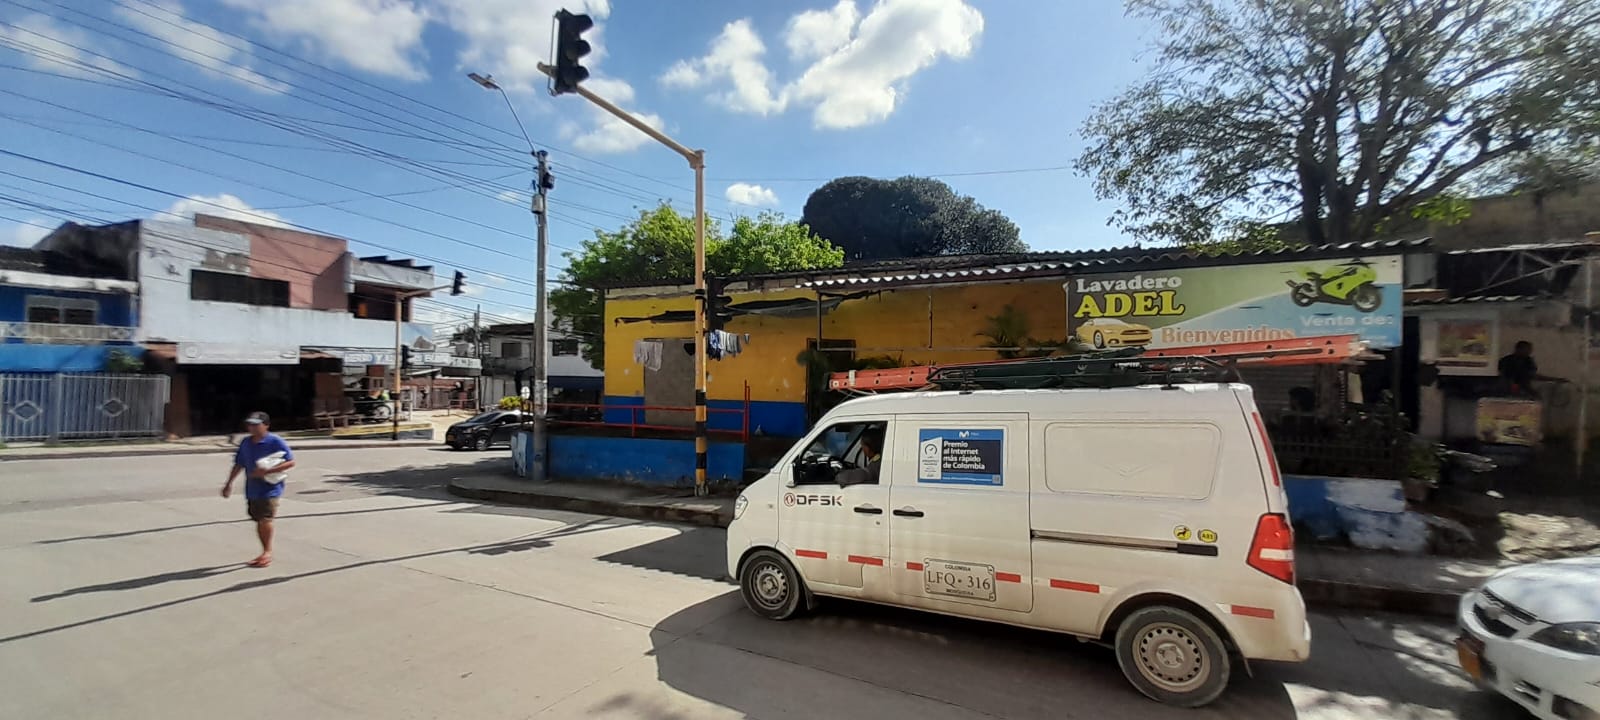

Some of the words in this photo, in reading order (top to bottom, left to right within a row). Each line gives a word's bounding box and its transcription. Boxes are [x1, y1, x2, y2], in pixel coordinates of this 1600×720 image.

[1076, 275, 1182, 292] Lavadero
[1073, 290, 1185, 318] ADEL
[1301, 315, 1355, 327] Venta
[1361, 314, 1393, 325] de:
[1161, 324, 1296, 342] Bienvenidos
[958, 455, 981, 463] rápido
[953, 462, 985, 470] Colombia
[797, 495, 842, 506] DFSK
[967, 576, 991, 590] 316
